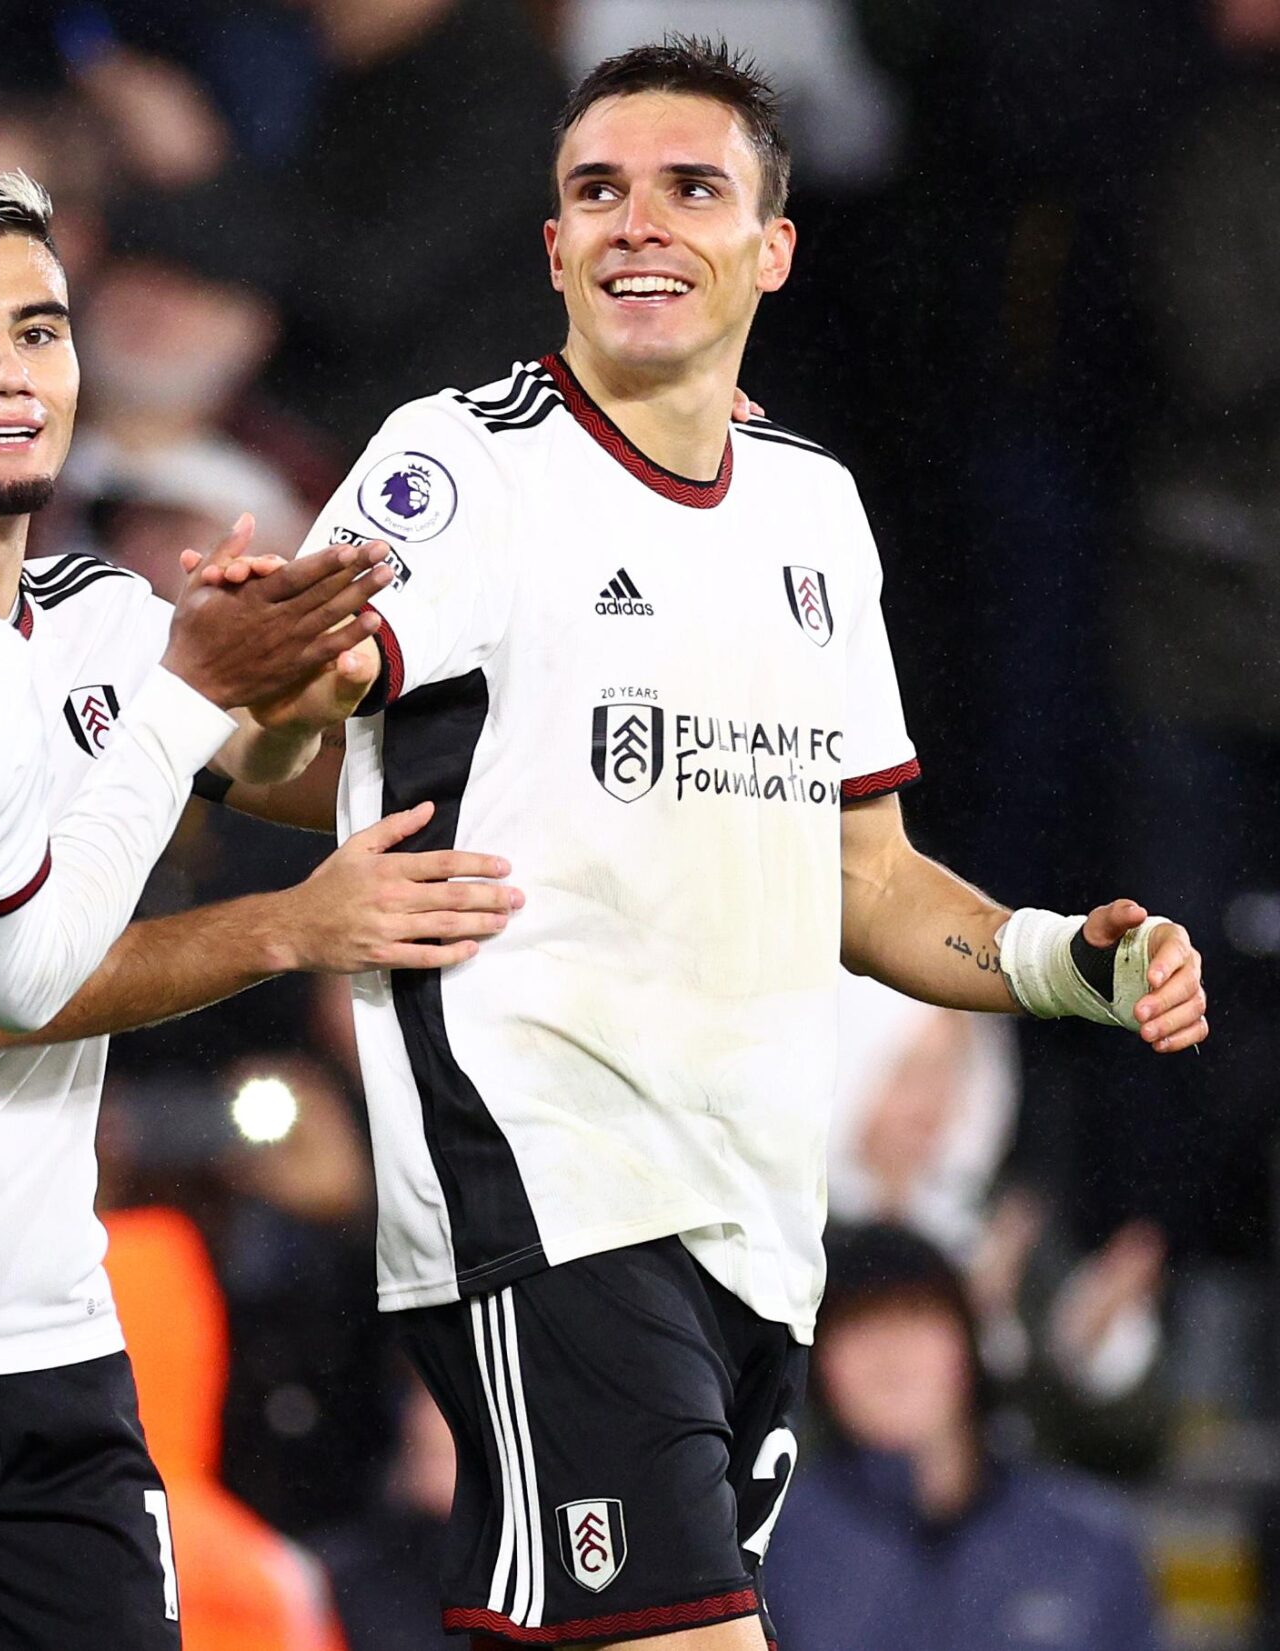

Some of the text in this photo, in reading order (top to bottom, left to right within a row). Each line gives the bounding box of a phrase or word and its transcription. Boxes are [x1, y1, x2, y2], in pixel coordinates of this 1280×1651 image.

[594, 598, 654, 616] adidas
[601, 686, 659, 700] 20 YEARS
[676, 715, 844, 764] FULHAM FC
